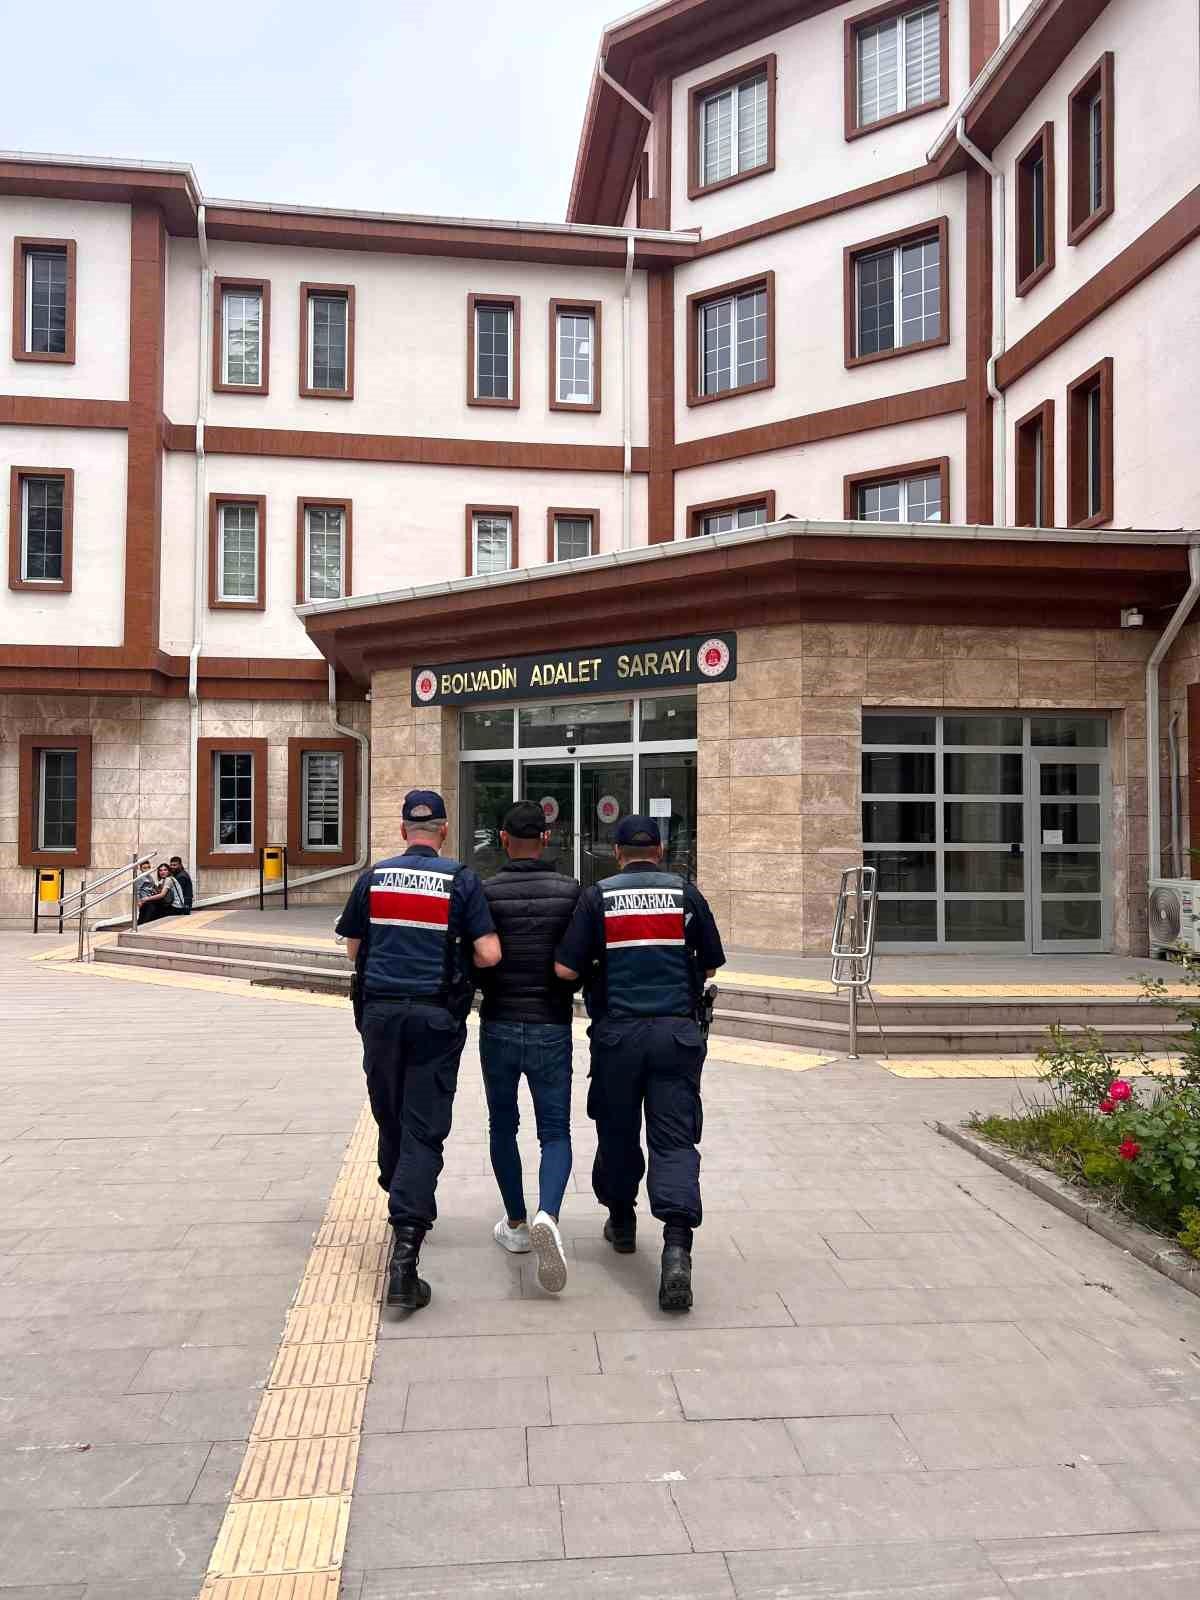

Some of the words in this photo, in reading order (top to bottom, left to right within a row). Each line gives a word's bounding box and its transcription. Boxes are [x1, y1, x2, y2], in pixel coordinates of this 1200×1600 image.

[440, 664, 518, 695] BOLVADİN
[530, 658, 602, 687] ADALET
[616, 649, 691, 678] SARAYI
[379, 872, 445, 892] JANDARMA
[611, 892, 676, 911] JANDARMA
